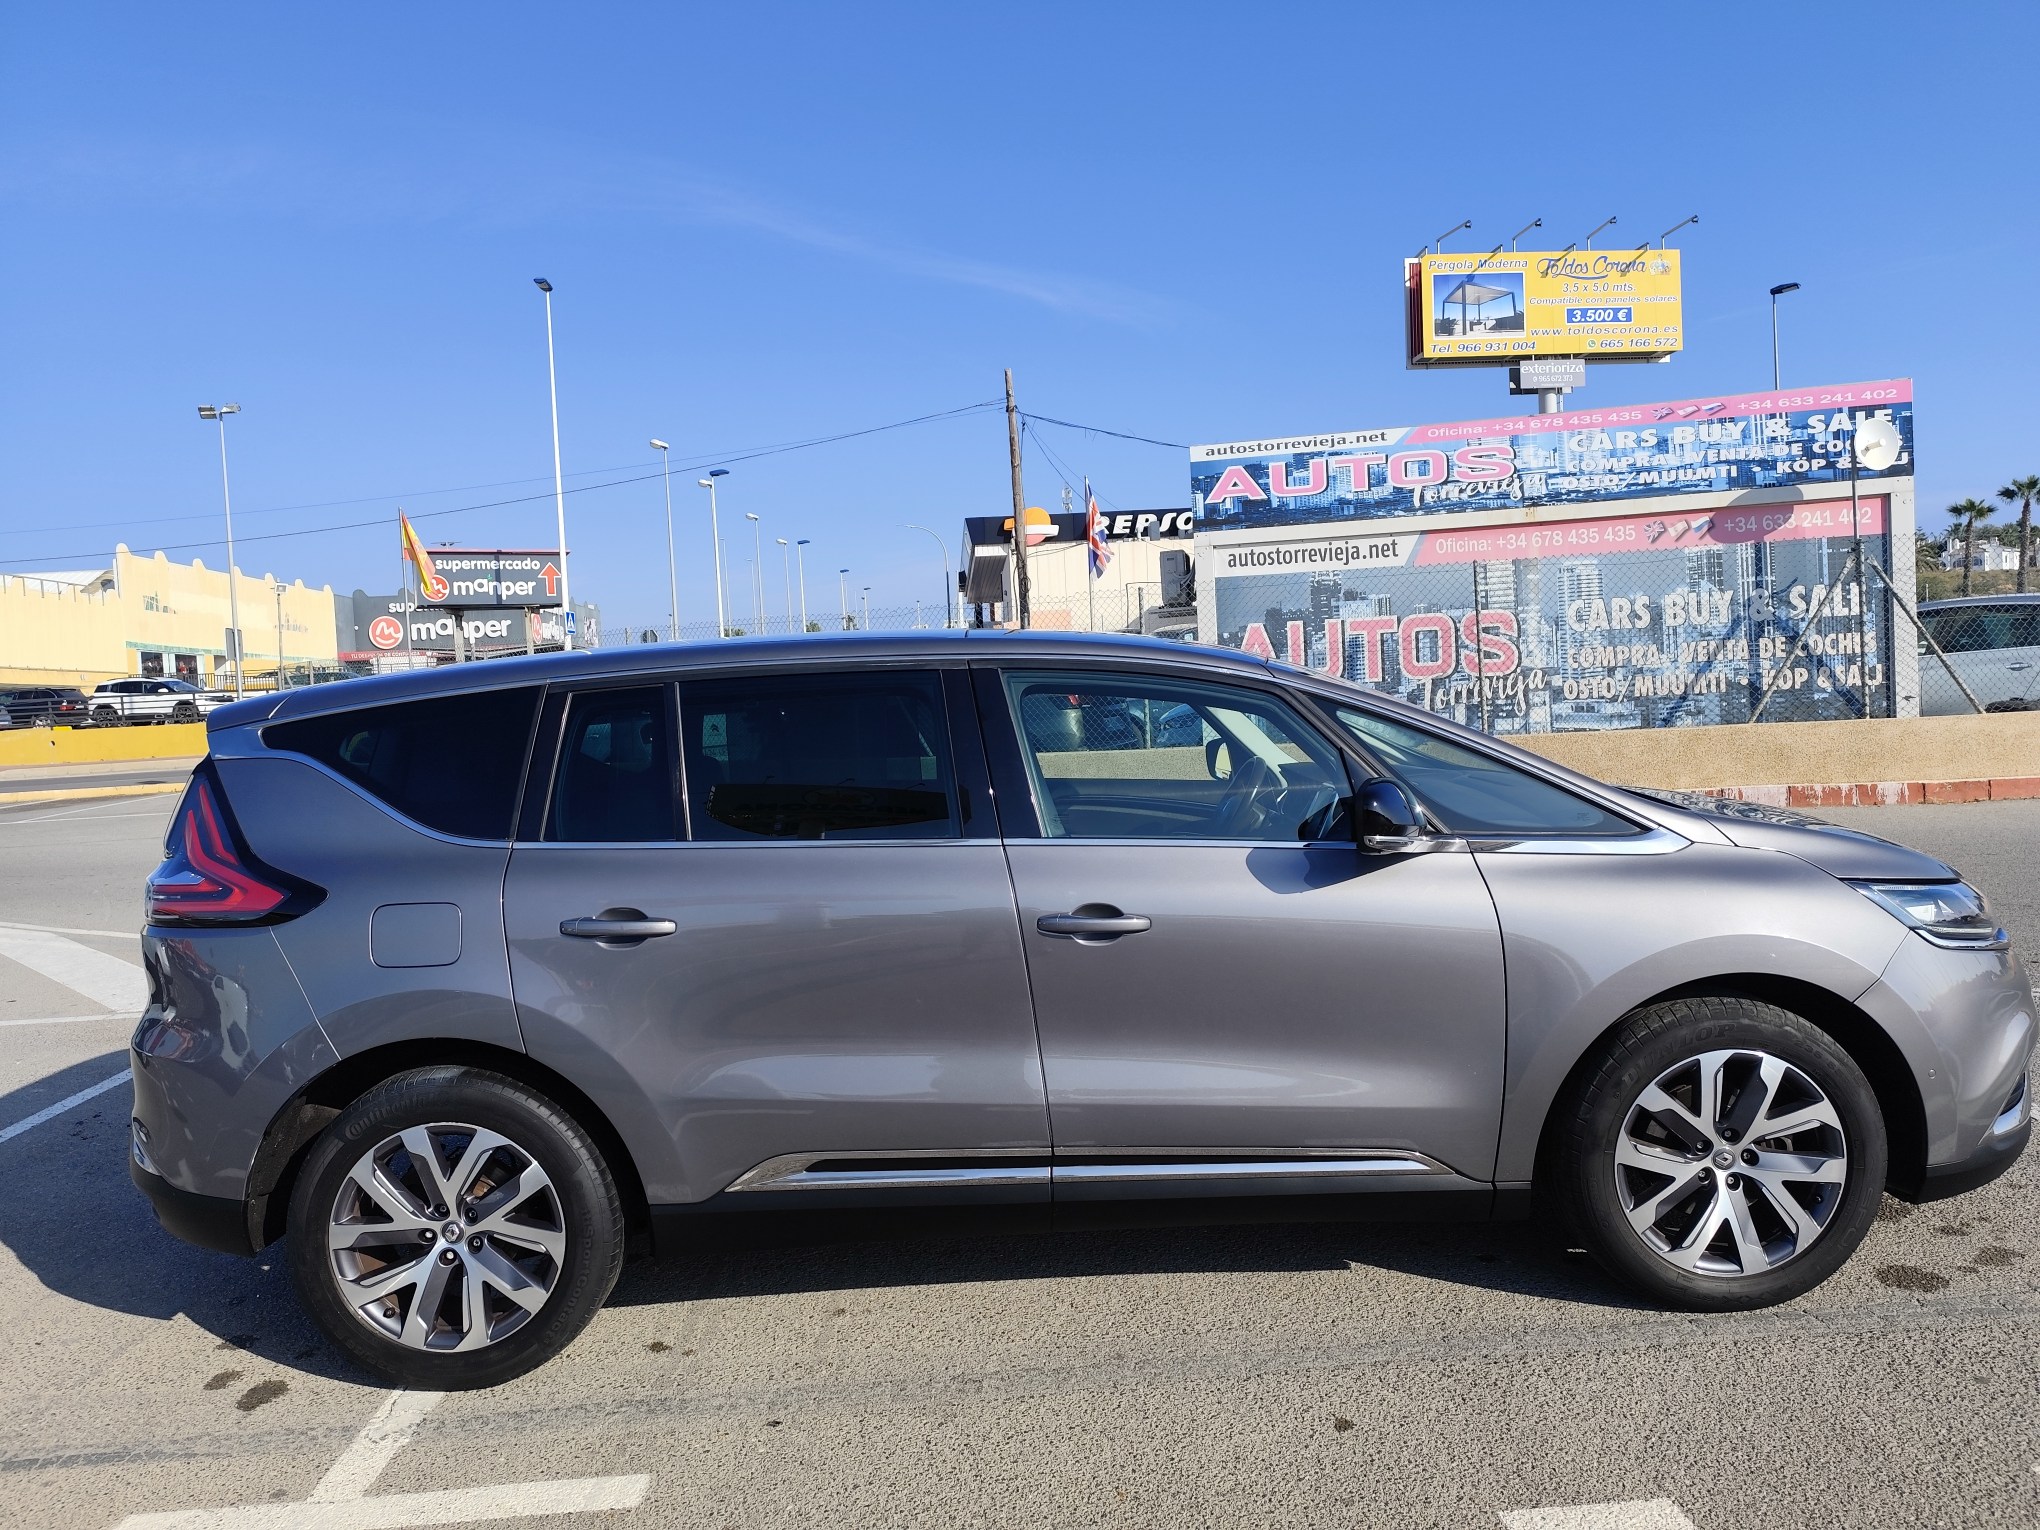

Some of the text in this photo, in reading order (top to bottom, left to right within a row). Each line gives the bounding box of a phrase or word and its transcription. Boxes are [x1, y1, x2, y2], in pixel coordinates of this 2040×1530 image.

[1477, 259, 1528, 270] Moderna
[1537, 255, 1647, 279] Toldos Corona
[1562, 283, 1636, 293] 3,5 x 5,0 mts.
[1530, 297, 1583, 305] Compatible
[1605, 296, 1641, 305] paneles
[1645, 295, 1678, 303] solares
[1572, 309, 1628, 322] 3.500 €
[1530, 325, 1678, 336] www.toldoscorona.es
[1431, 341, 1536, 353] Tel. 966 931 004
[1600, 338, 1678, 348] 665 166 572
[1521, 362, 1584, 373] exterioriza
[1737, 390, 1897, 411] +34 633 241 402
[1428, 411, 1642, 437] Oficina: +34 678 435 435
[1206, 431, 1388, 457] autostorrevieja.net
[1569, 428, 1658, 452] CARS
[1673, 420, 1749, 445] BUY
[1765, 419, 1792, 437] &
[1774, 442, 1802, 457] DE
[1205, 445, 1517, 504] AUTOS
[1777, 456, 1826, 474] KÖP
[1406, 472, 1548, 508] Torrevieja
[1724, 516, 1757, 533] +34
[1762, 514, 1796, 530] 633
[1801, 511, 1833, 528] 241
[1435, 525, 1636, 554] Oficina: +34 678 435 435
[1228, 539, 1398, 568] autostorrevieja.net
[435, 557, 541, 573] supermercado
[453, 578, 536, 600] manper
[1568, 596, 1651, 632] CARS
[1664, 590, 1734, 627] BUY
[1750, 588, 1775, 621] &
[1240, 610, 1519, 682] AUTOS
[1678, 639, 1749, 663] VENTA
[1760, 637, 1786, 659] DE
